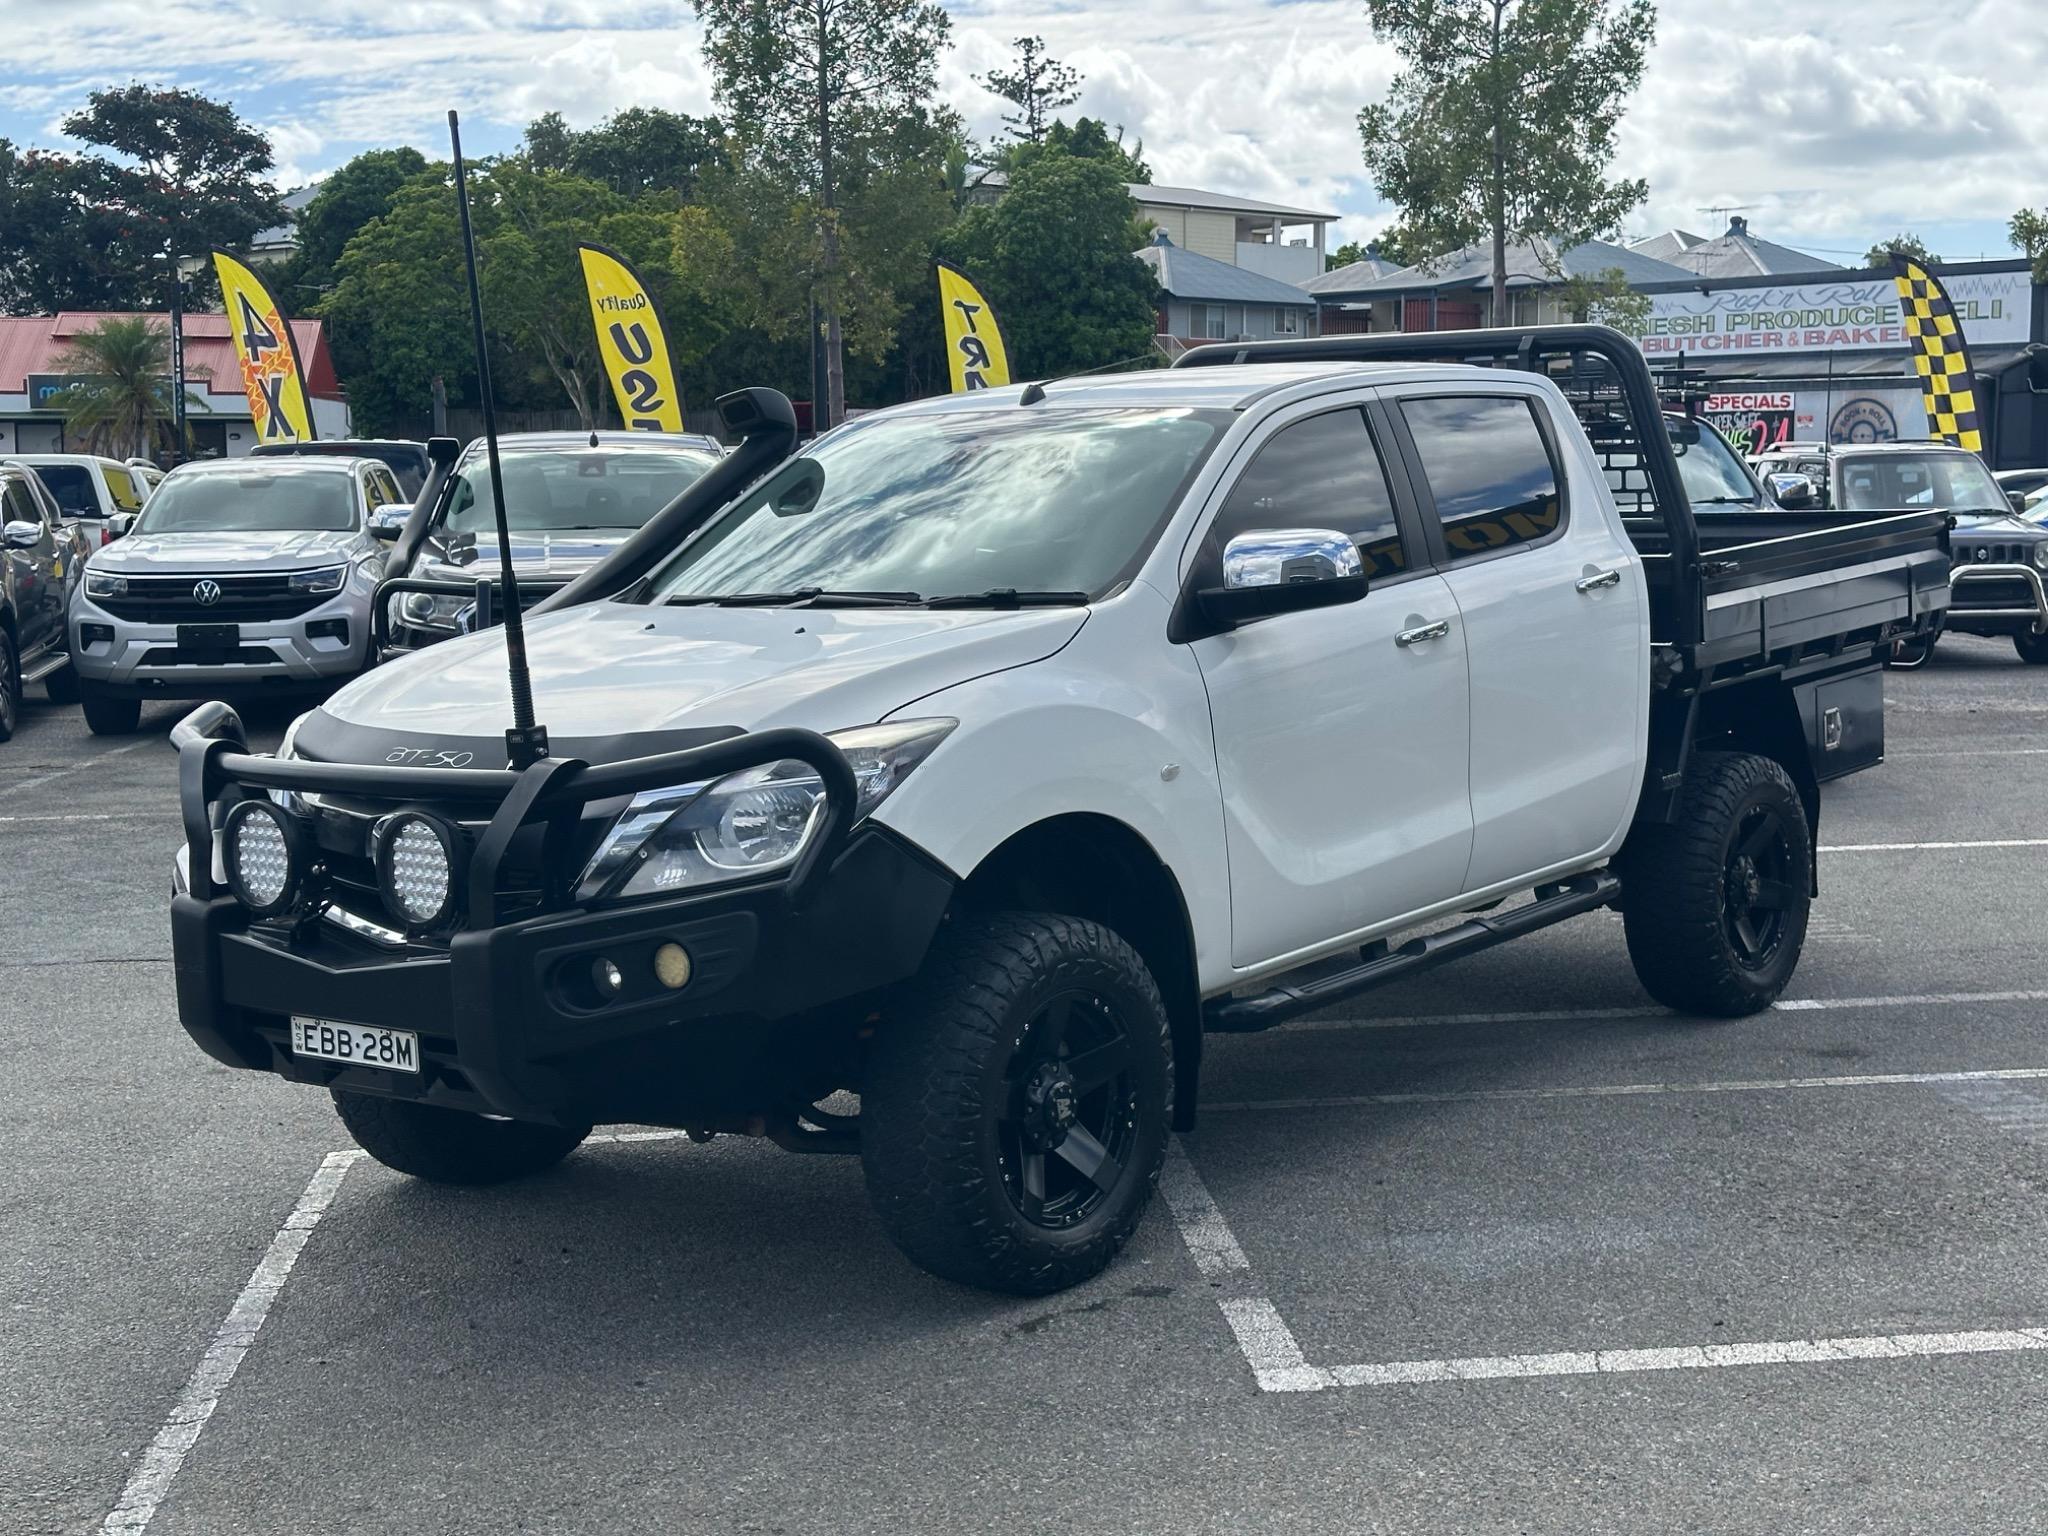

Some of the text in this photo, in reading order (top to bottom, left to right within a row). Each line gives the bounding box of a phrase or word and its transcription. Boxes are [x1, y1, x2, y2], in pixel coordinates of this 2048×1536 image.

[1726, 305, 1898, 332] PRODUCE
[1642, 331, 1783, 353] BUTCHER
[1787, 331, 1799, 347] &
[1708, 395, 1791, 409] SPECIALS
[385, 746, 473, 768] BT-50
